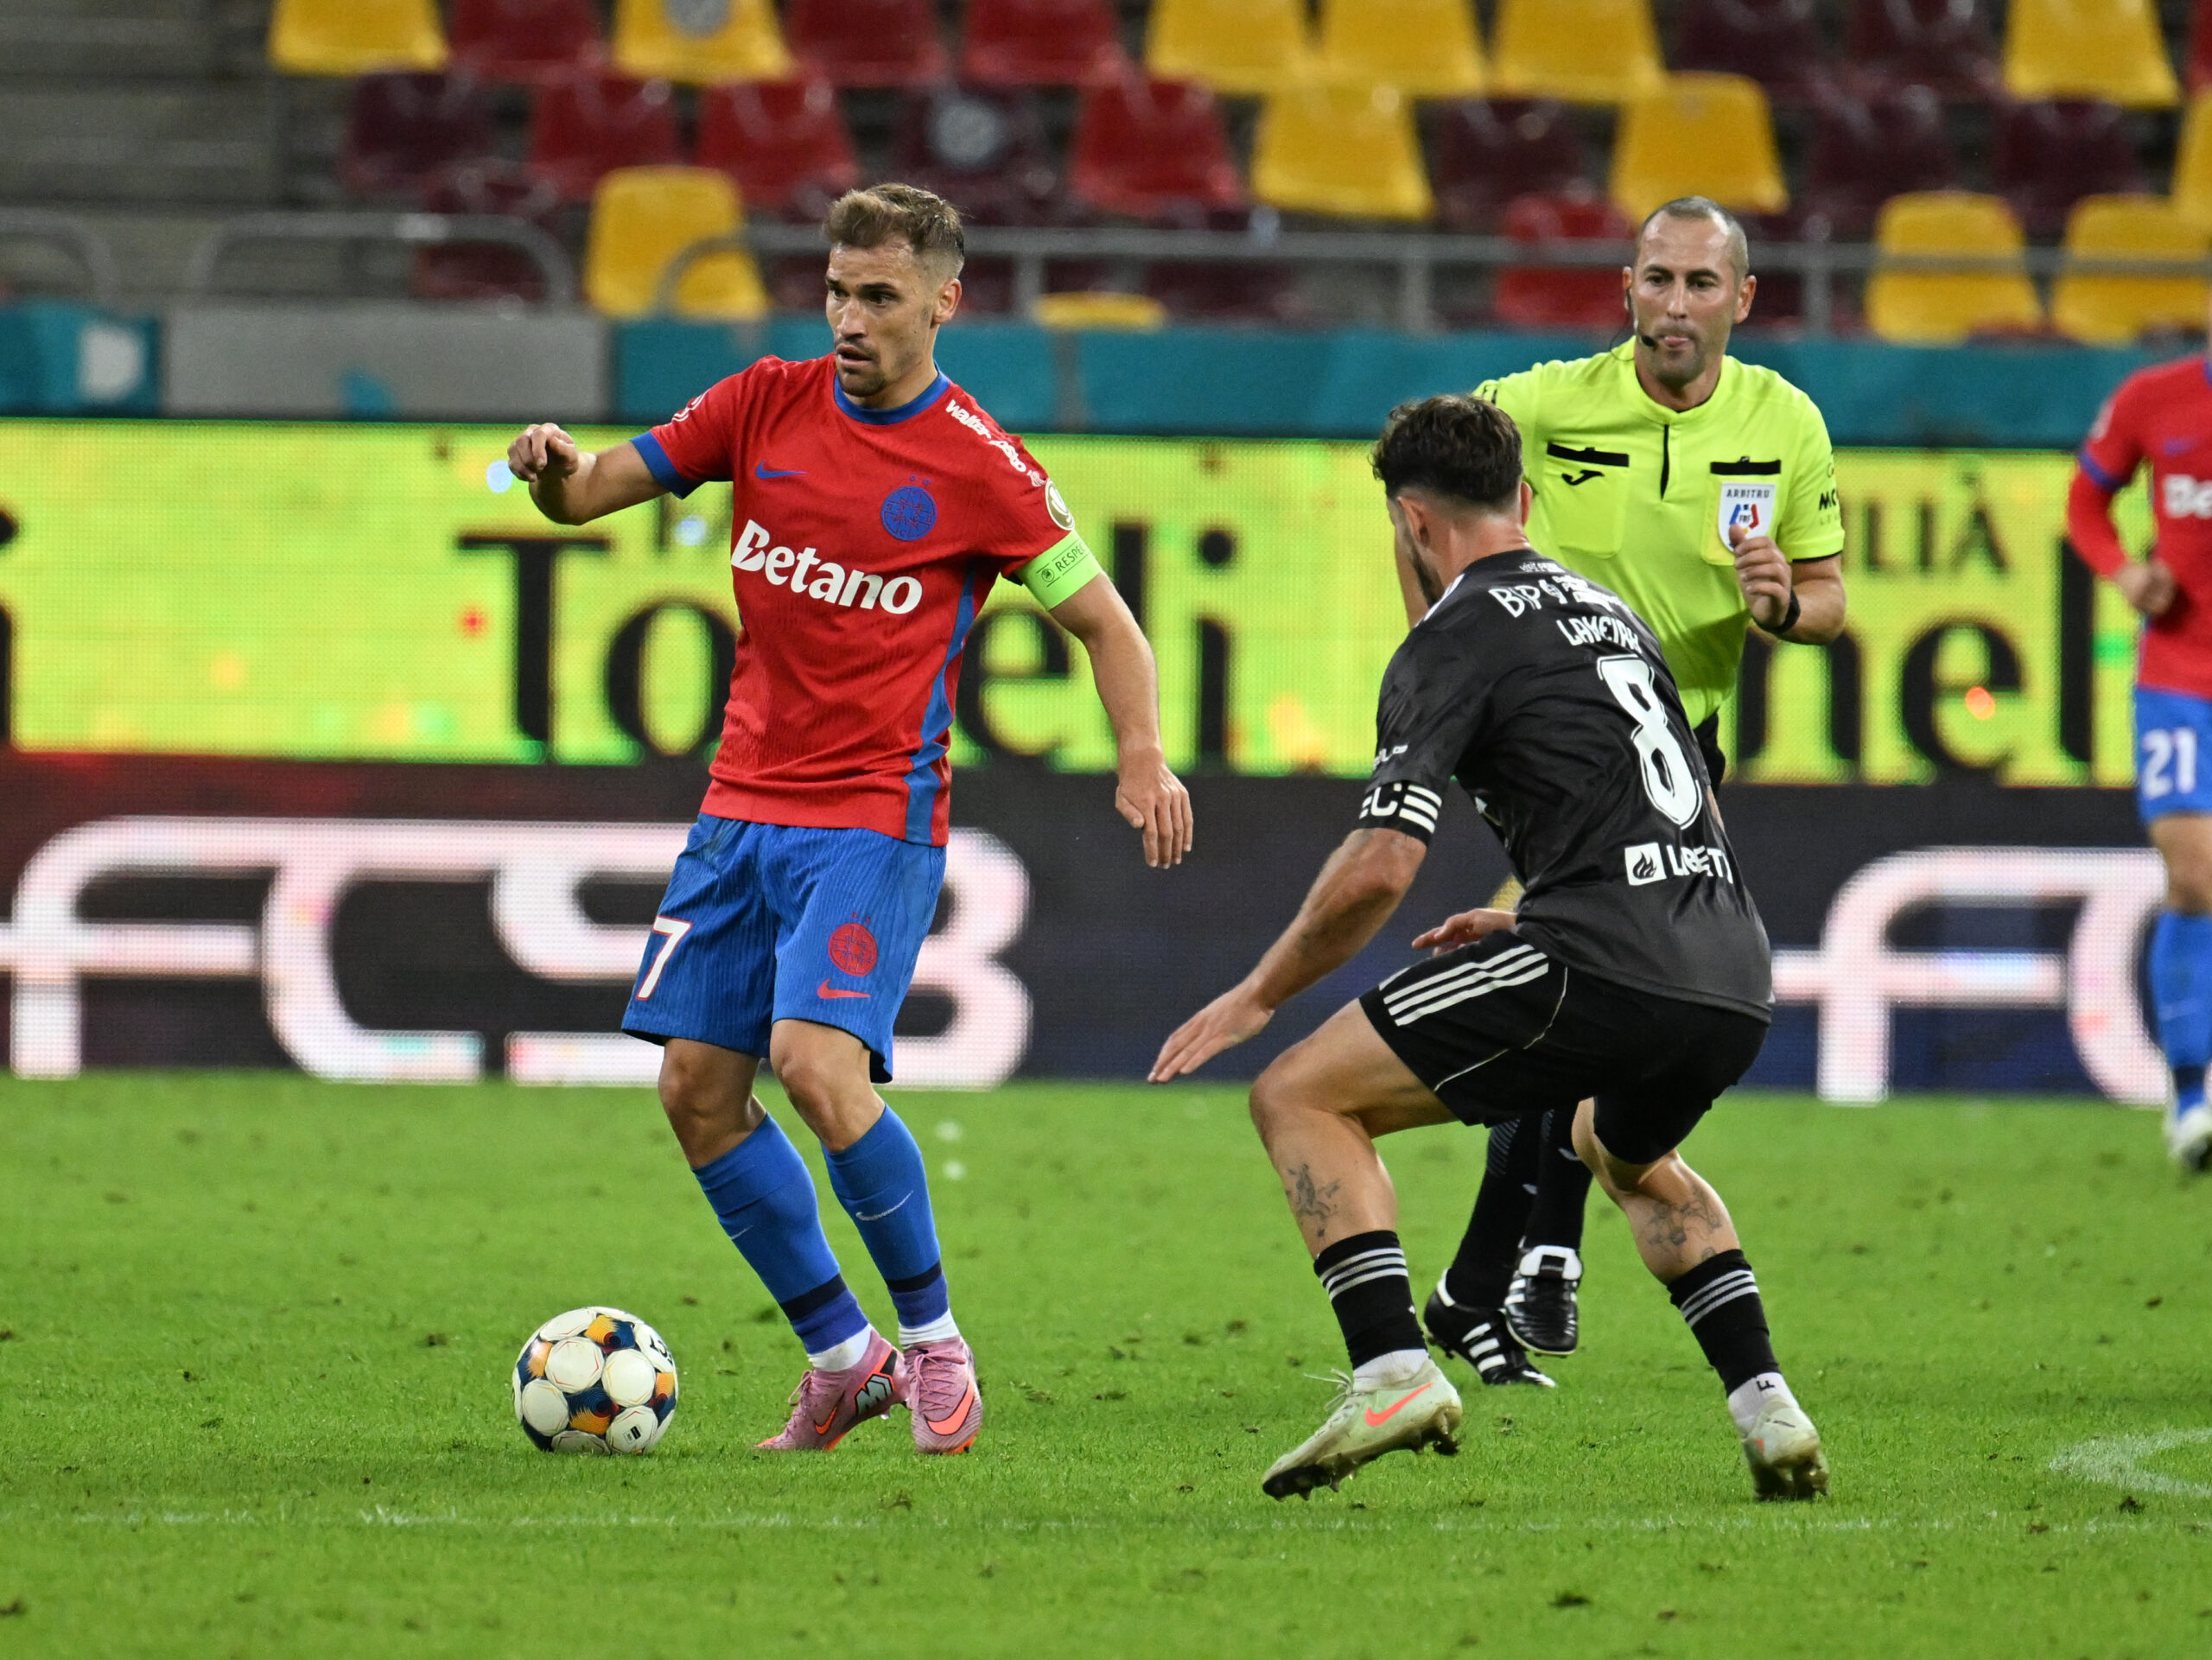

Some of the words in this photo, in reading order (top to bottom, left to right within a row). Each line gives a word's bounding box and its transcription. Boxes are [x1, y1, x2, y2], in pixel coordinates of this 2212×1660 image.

[1726, 487, 1771, 499] ARBITRU
[730, 518, 923, 615] Betano
[1596, 653, 1701, 830] 8
[2141, 724, 2197, 800] 21
[635, 915, 692, 1002] 7
